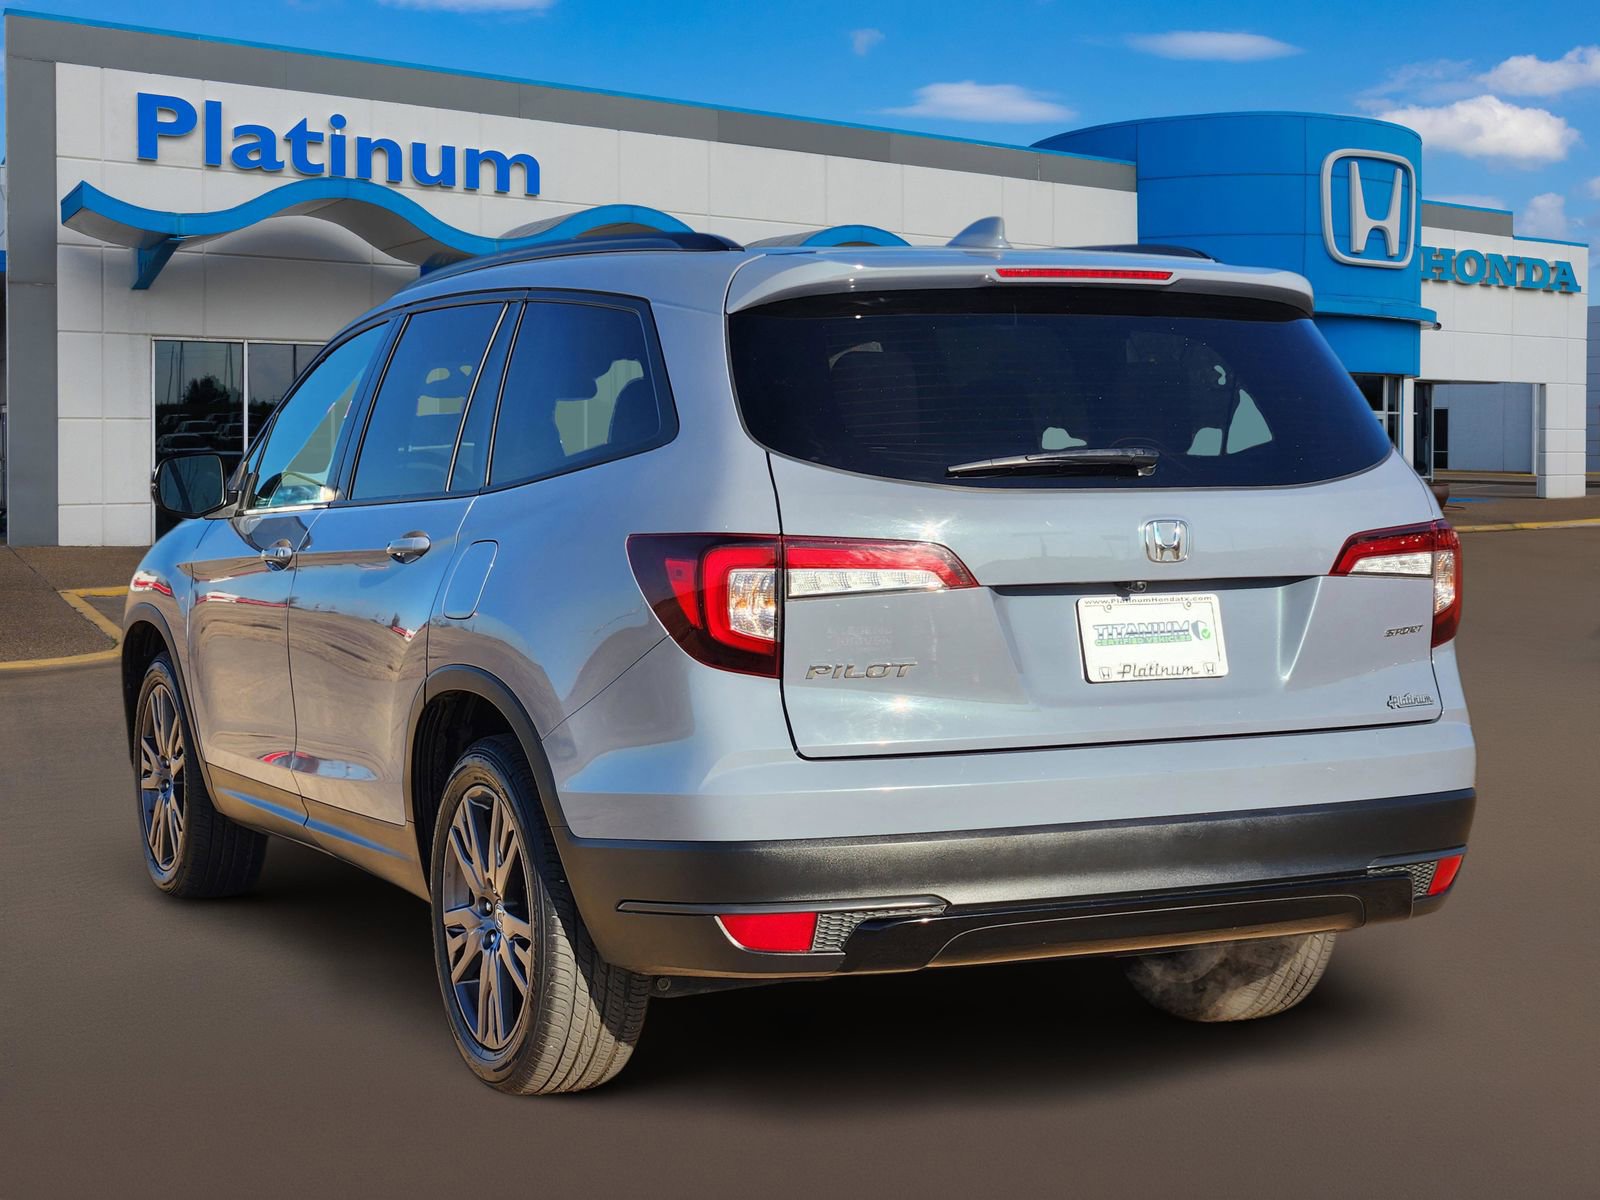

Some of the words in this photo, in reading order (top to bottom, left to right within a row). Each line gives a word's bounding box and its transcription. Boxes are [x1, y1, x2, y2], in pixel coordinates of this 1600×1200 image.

[136, 91, 541, 197] Platinum
[1421, 246, 1582, 293] HONDA
[1092, 620, 1190, 640] TITANIUM
[1384, 624, 1424, 638] SPORT
[805, 661, 918, 680] PILOT
[1117, 662, 1200, 679] Platinum
[1387, 692, 1435, 709] Platinum
